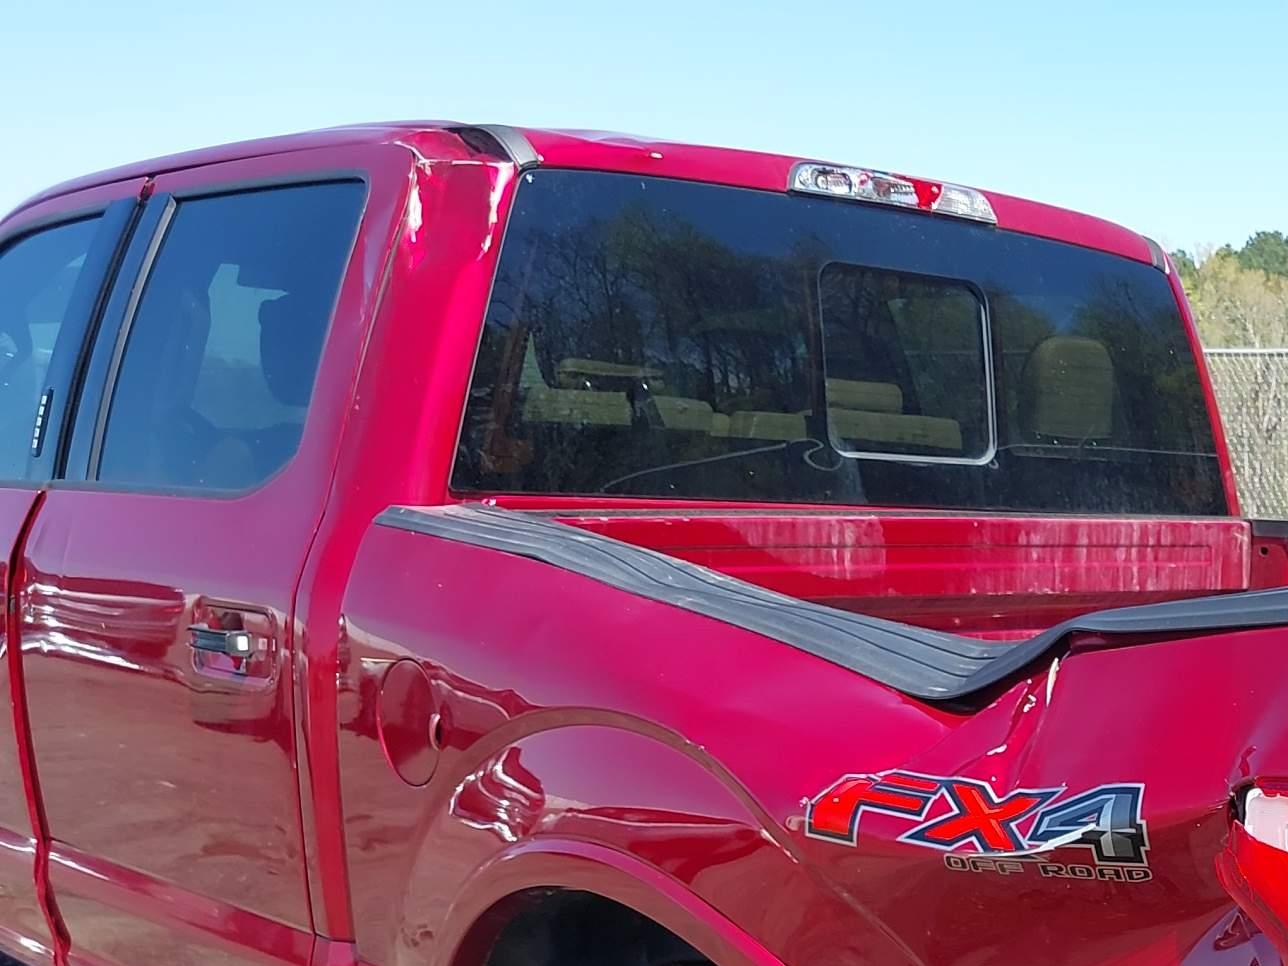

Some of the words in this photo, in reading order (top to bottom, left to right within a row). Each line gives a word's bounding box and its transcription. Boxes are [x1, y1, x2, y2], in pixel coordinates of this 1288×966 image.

[804, 769, 1151, 867] FX4
[944, 853, 1025, 875] OFF
[1039, 862, 1154, 883] ROAD
